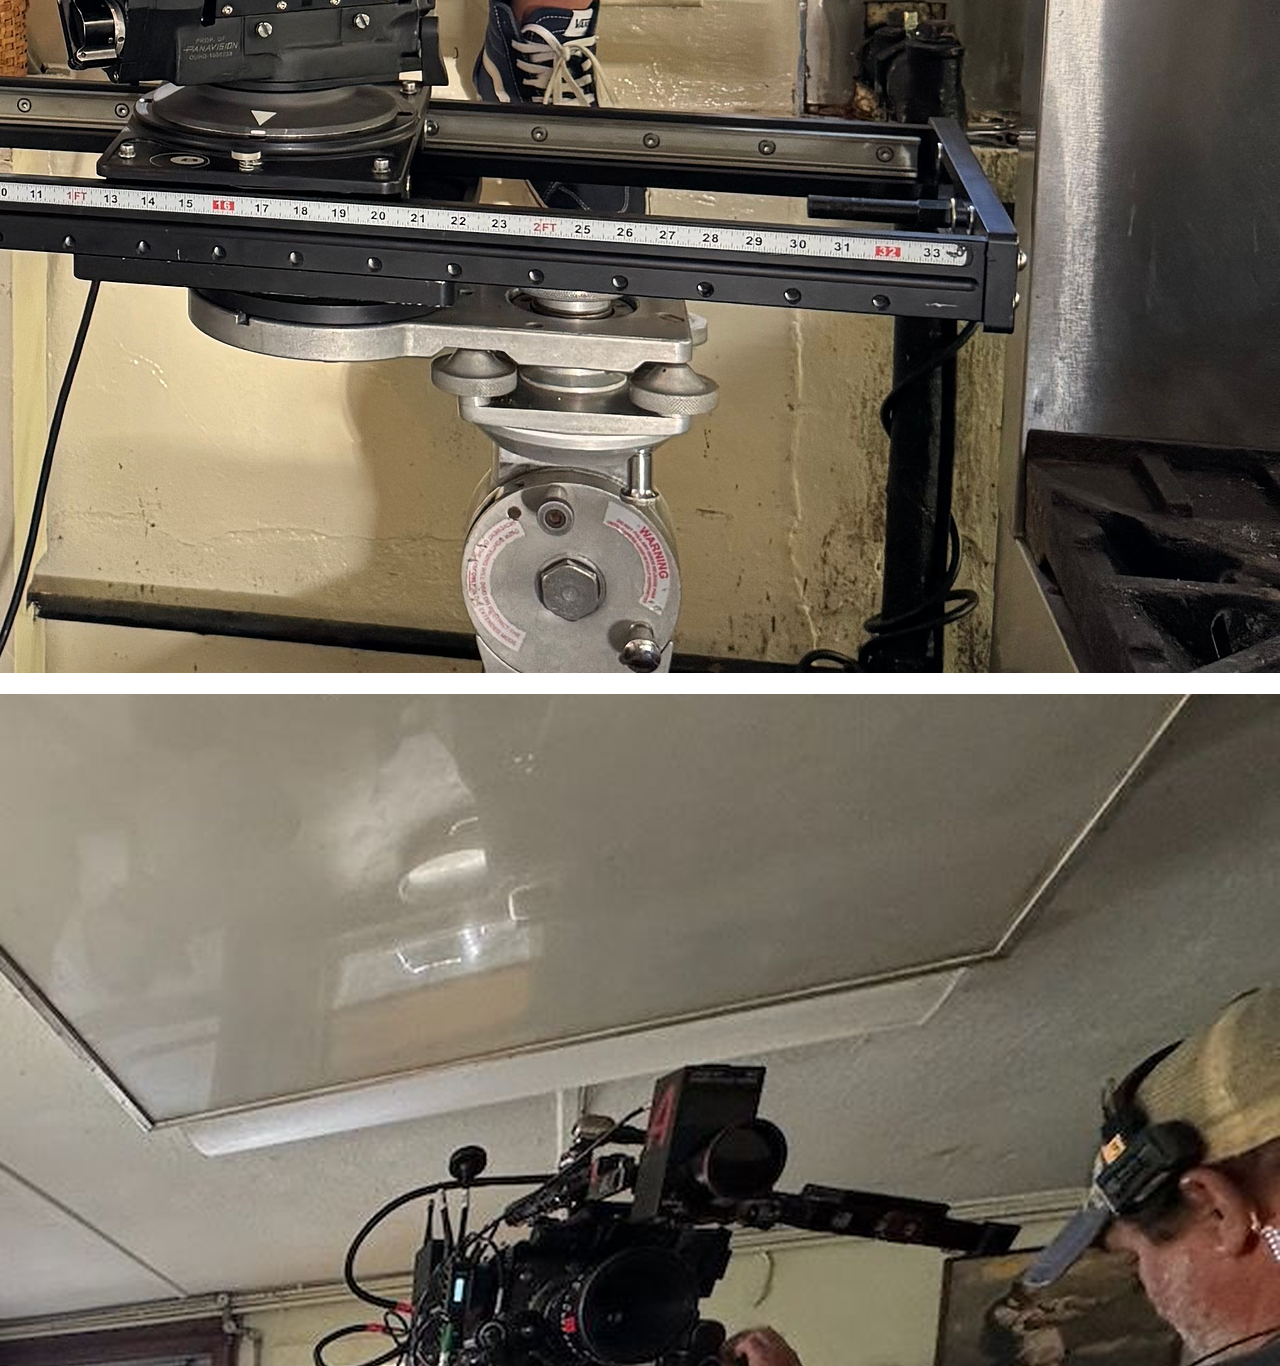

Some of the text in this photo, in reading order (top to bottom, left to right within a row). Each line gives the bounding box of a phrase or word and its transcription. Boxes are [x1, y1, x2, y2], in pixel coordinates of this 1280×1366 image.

[30, 190, 42, 198] 11
[104, 194, 118, 204] 13
[141, 196, 155, 206] 14
[179, 198, 193, 208] 15
[215, 200, 230, 210] 16
[255, 203, 269, 213] 17
[294, 206, 308, 216] 18
[332, 208, 346, 218] 19
[371, 211, 386, 221] 20
[410, 213, 425, 223] 21
[451, 216, 466, 226] 22
[492, 219, 507, 229] 23
[575, 225, 591, 234] 25
[617, 227, 633, 238] 26
[659, 230, 675, 240] 27
[702, 233, 719, 243] 28
[745, 236, 763, 246] 29
[790, 238, 807, 249] 30
[834, 242, 850, 252] 31
[879, 246, 897, 256] 32
[923, 248, 941, 258] 33
[639, 525, 669, 580] WARNING
